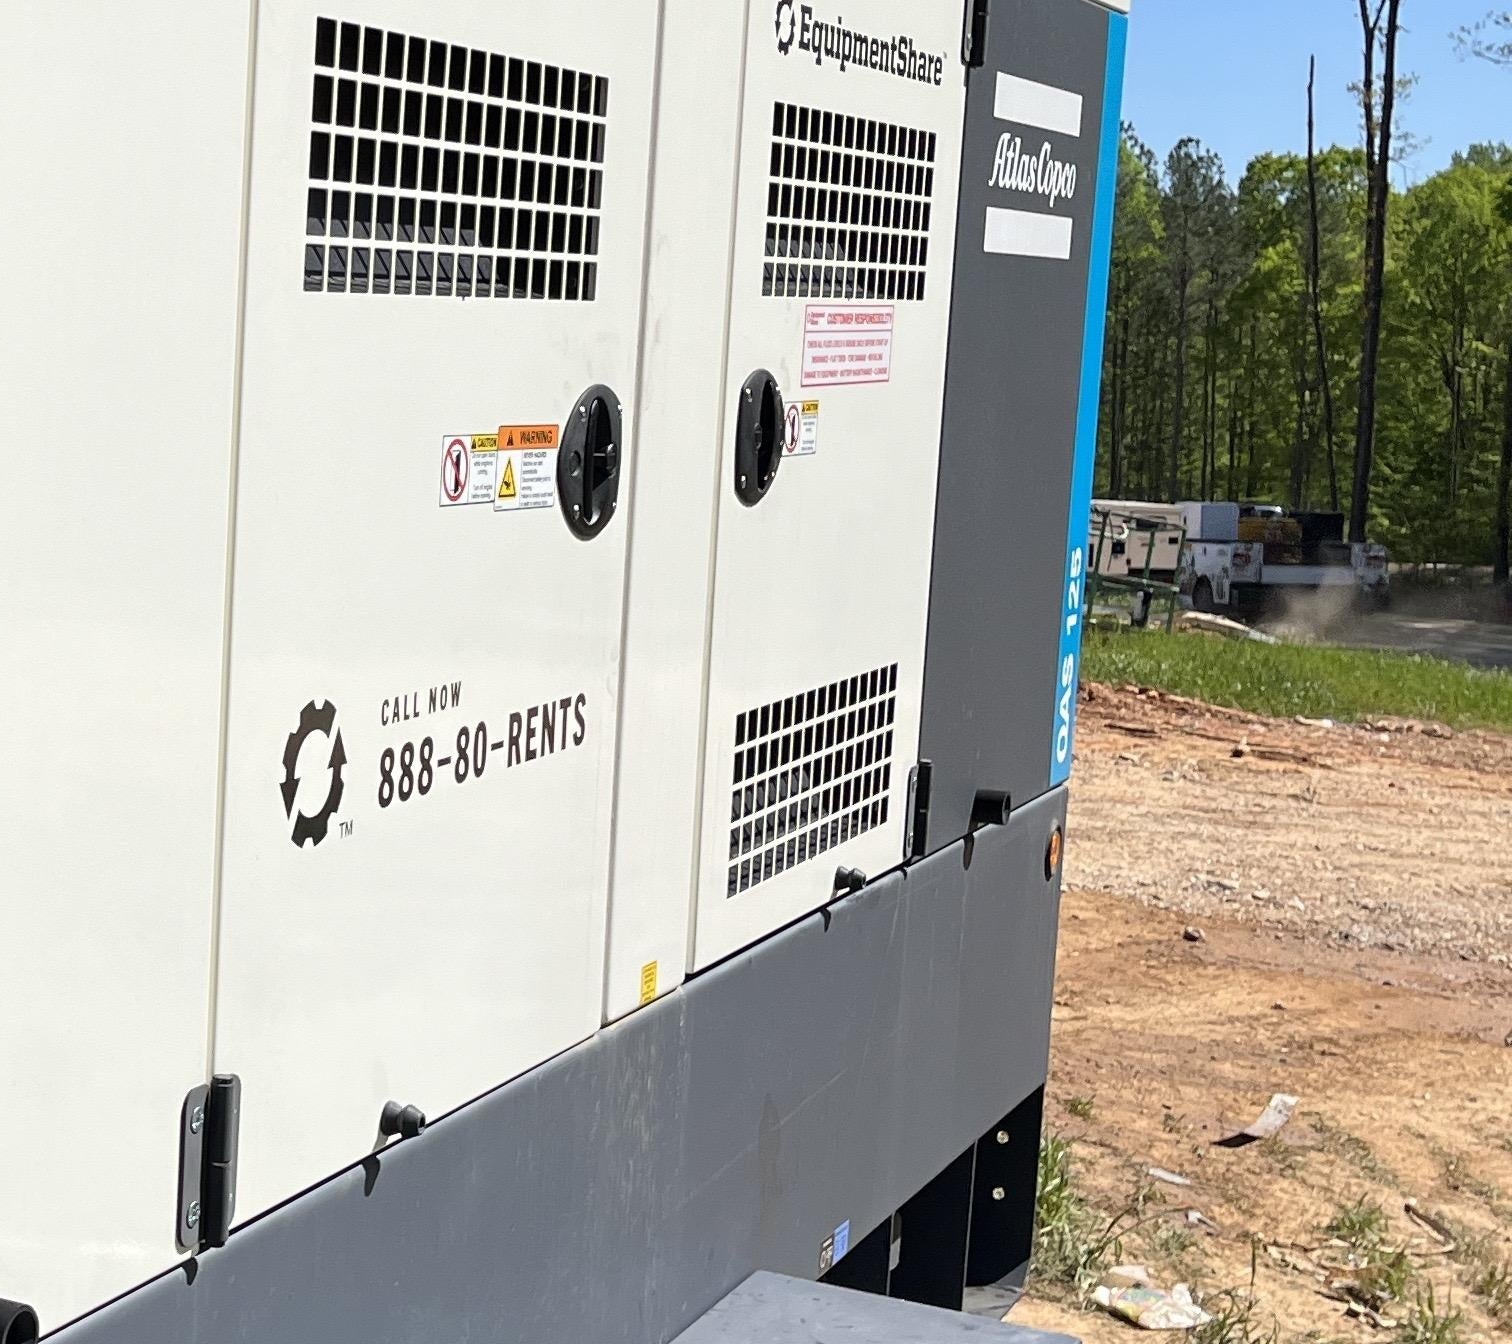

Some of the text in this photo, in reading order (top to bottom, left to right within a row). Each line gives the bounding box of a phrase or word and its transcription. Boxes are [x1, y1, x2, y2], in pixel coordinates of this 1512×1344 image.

[798, 4, 943, 86] EquipmentShare
[988, 132, 1078, 208] Atlas Copco
[519, 430, 553, 445] WARNING
[1065, 546, 1083, 636] 125
[381, 680, 462, 727] CALL NOW
[378, 692, 586, 809] 888-80-RENTS
